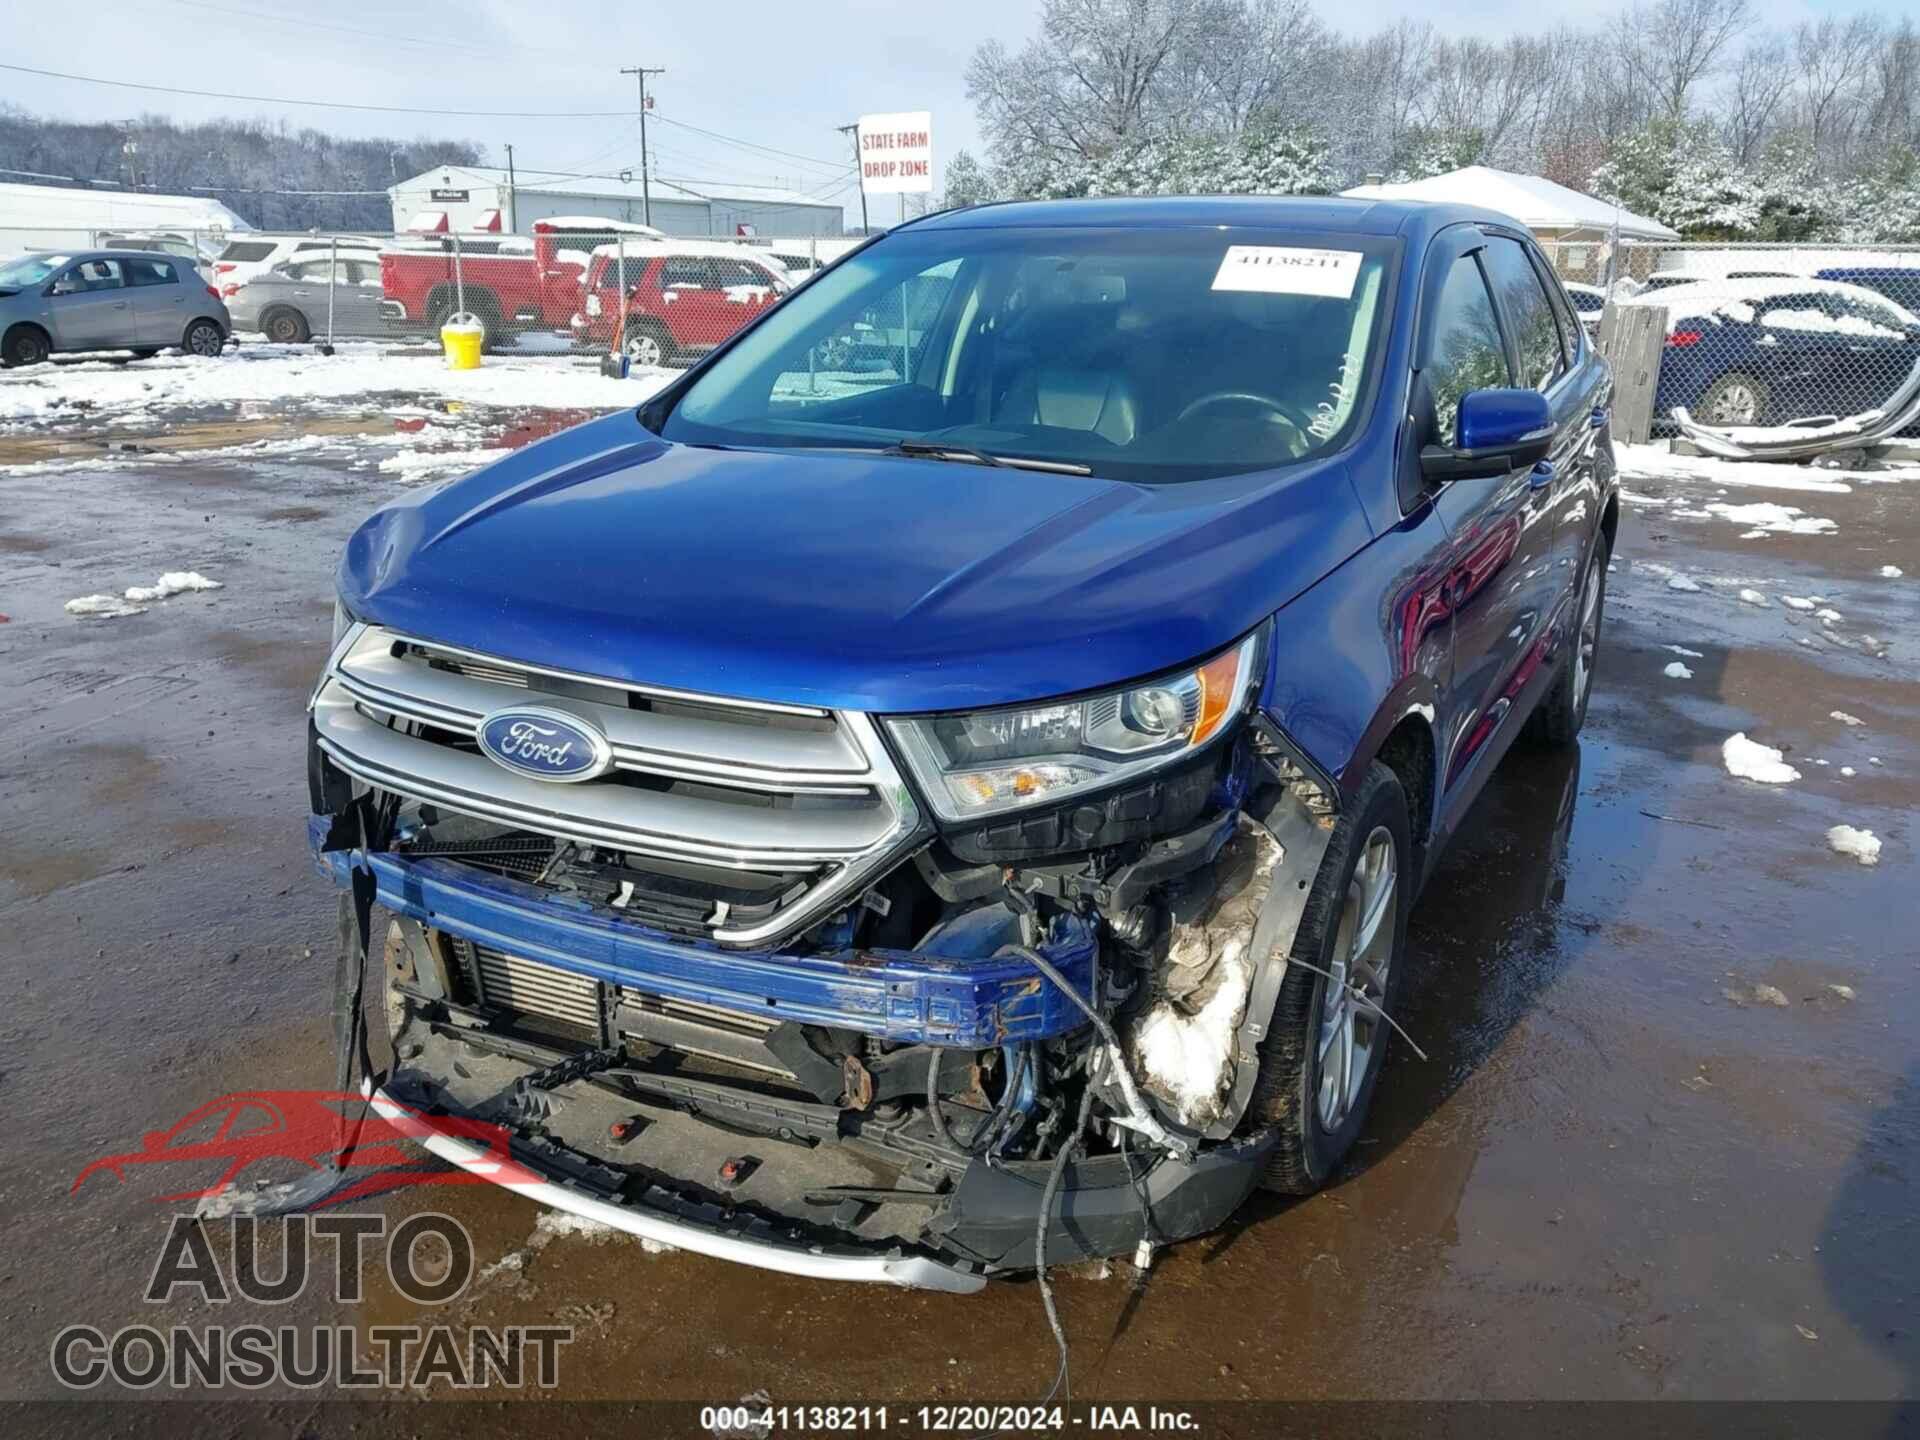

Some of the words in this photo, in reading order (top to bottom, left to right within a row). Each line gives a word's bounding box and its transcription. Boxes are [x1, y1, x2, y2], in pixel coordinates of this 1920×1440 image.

[863, 132, 895, 151] STATE
[897, 130, 928, 149] FARM
[864, 161, 897, 178] DROP
[899, 160, 929, 177] ZONE
[1236, 255, 1341, 269] 41138211
[500, 721, 573, 766] Ford
